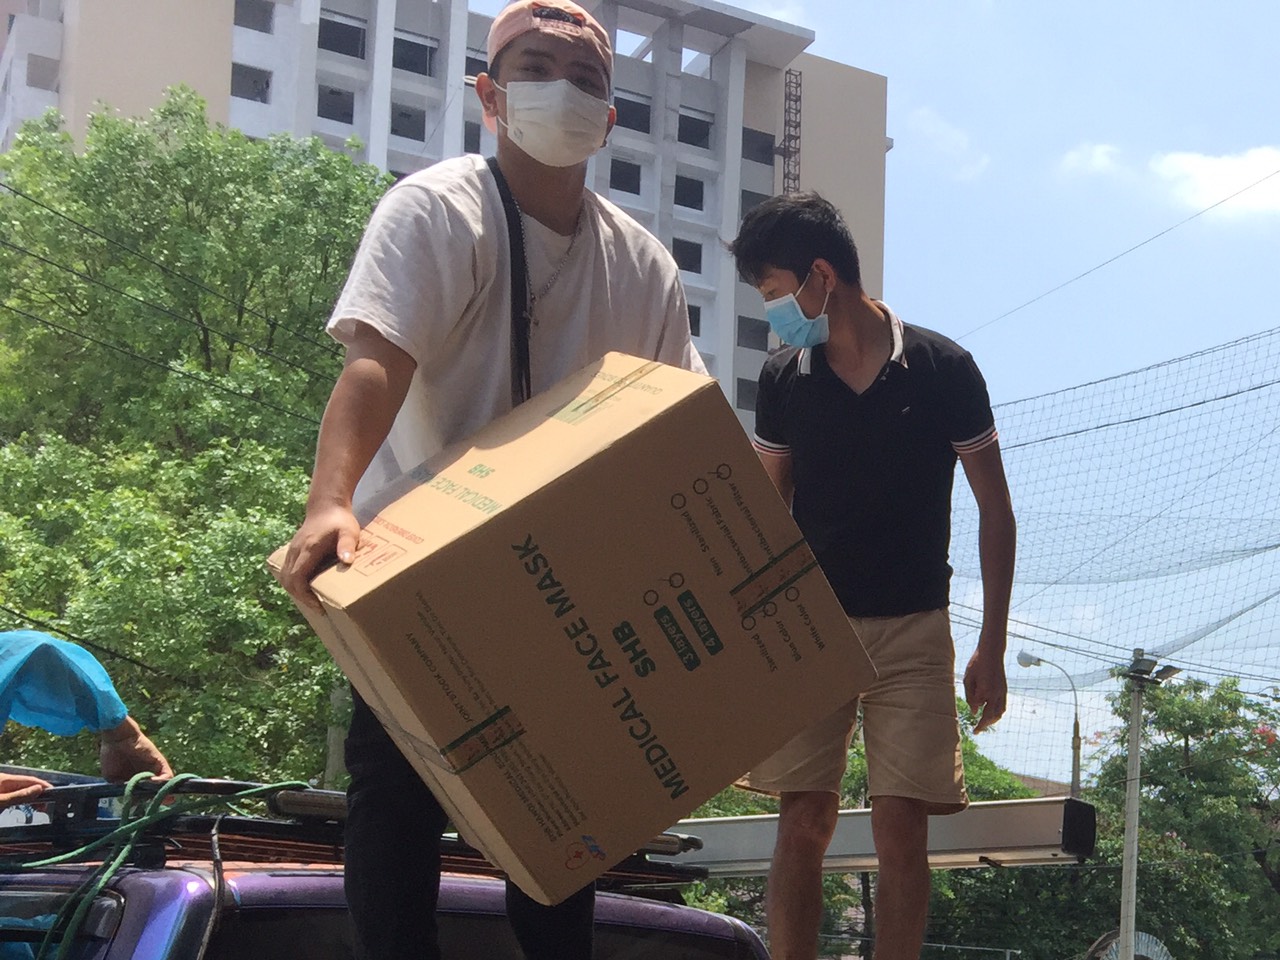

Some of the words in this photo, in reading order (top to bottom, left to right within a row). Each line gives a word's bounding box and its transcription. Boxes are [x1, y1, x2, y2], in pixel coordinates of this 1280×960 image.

[430, 476, 461, 496] FACE
[468, 463, 496, 479] SHB
[455, 487, 503, 515] MEDICAL
[508, 532, 577, 620] MASK
[657, 611, 690, 654] layers
[680, 595, 713, 637] layers
[562, 615, 621, 689] FACE
[608, 617, 658, 681] SHB
[681, 650, 695, 664] 3
[704, 635, 718, 649] 4
[606, 685, 691, 802] MEDICAL
